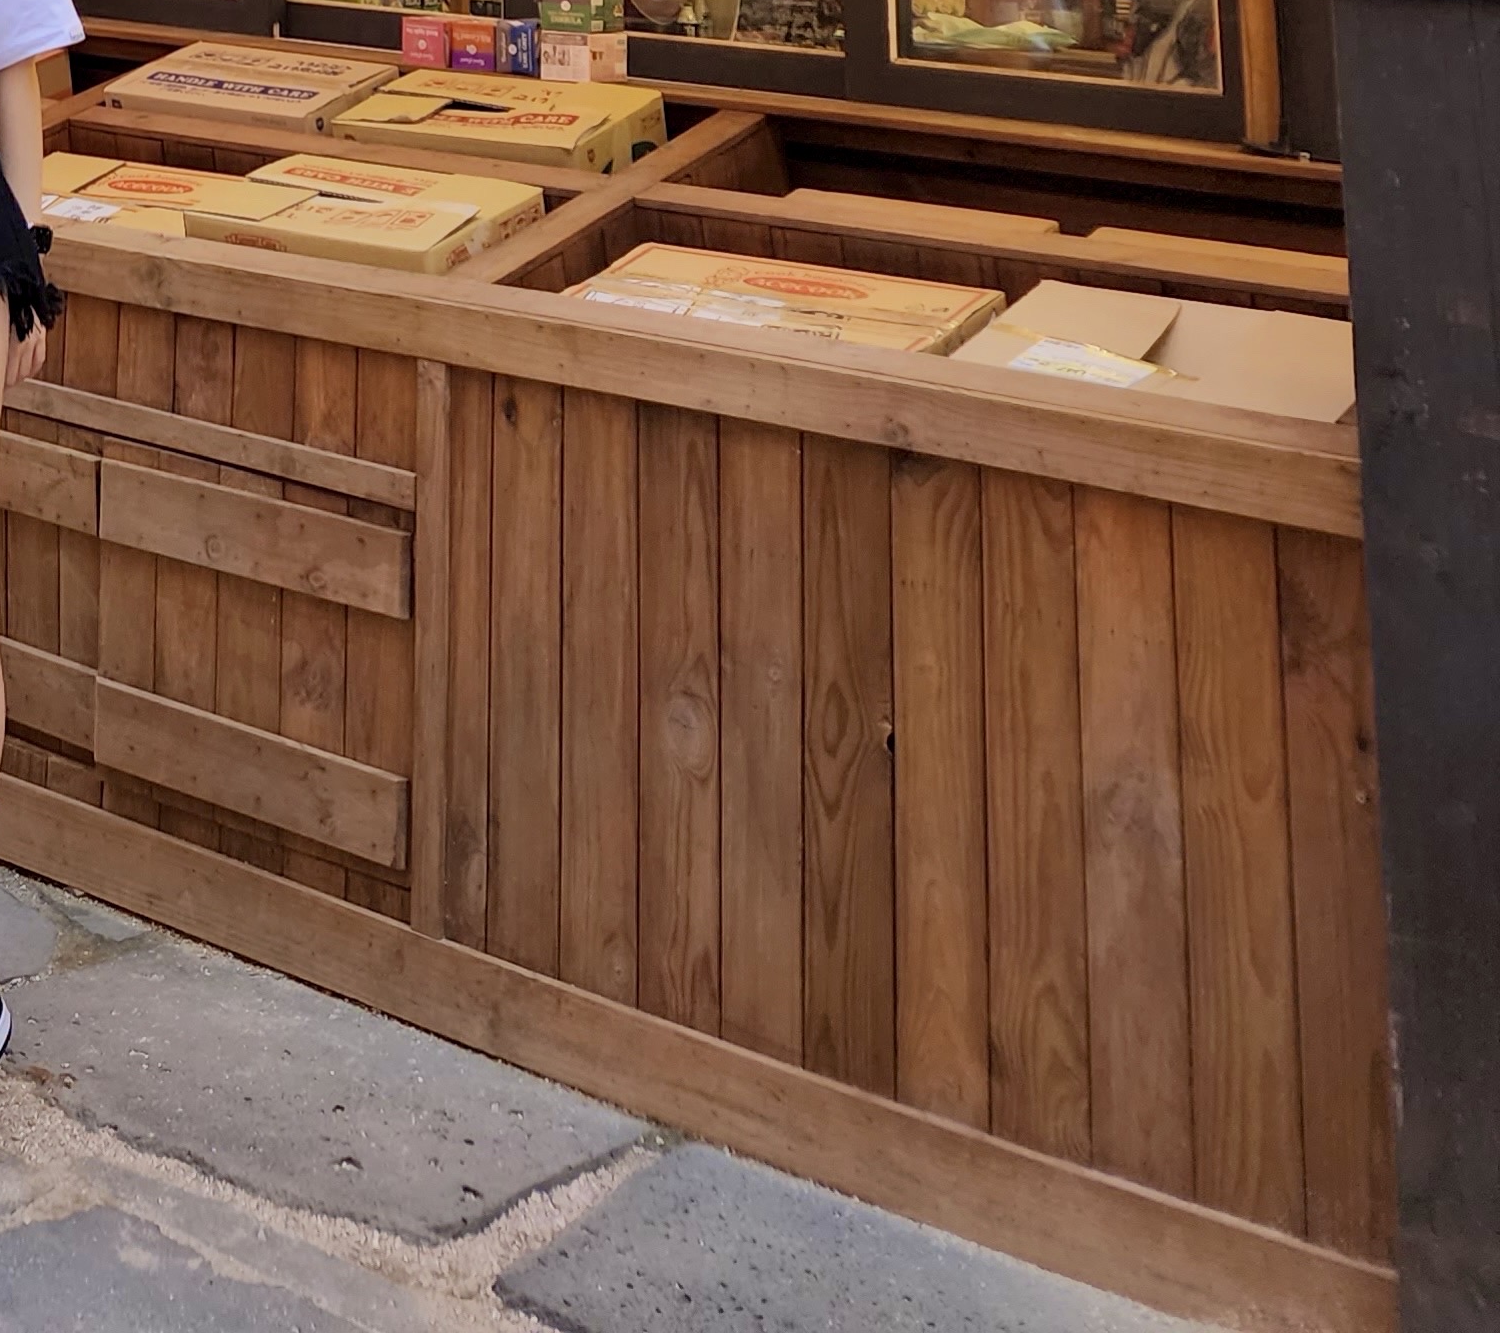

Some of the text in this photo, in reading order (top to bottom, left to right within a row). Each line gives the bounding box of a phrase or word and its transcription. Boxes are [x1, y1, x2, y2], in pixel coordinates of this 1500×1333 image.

[153, 71, 218, 88] HANDLE
[221, 81, 265, 95] WITH
[266, 87, 318, 99] CARE
[518, 113, 575, 126] CARE
